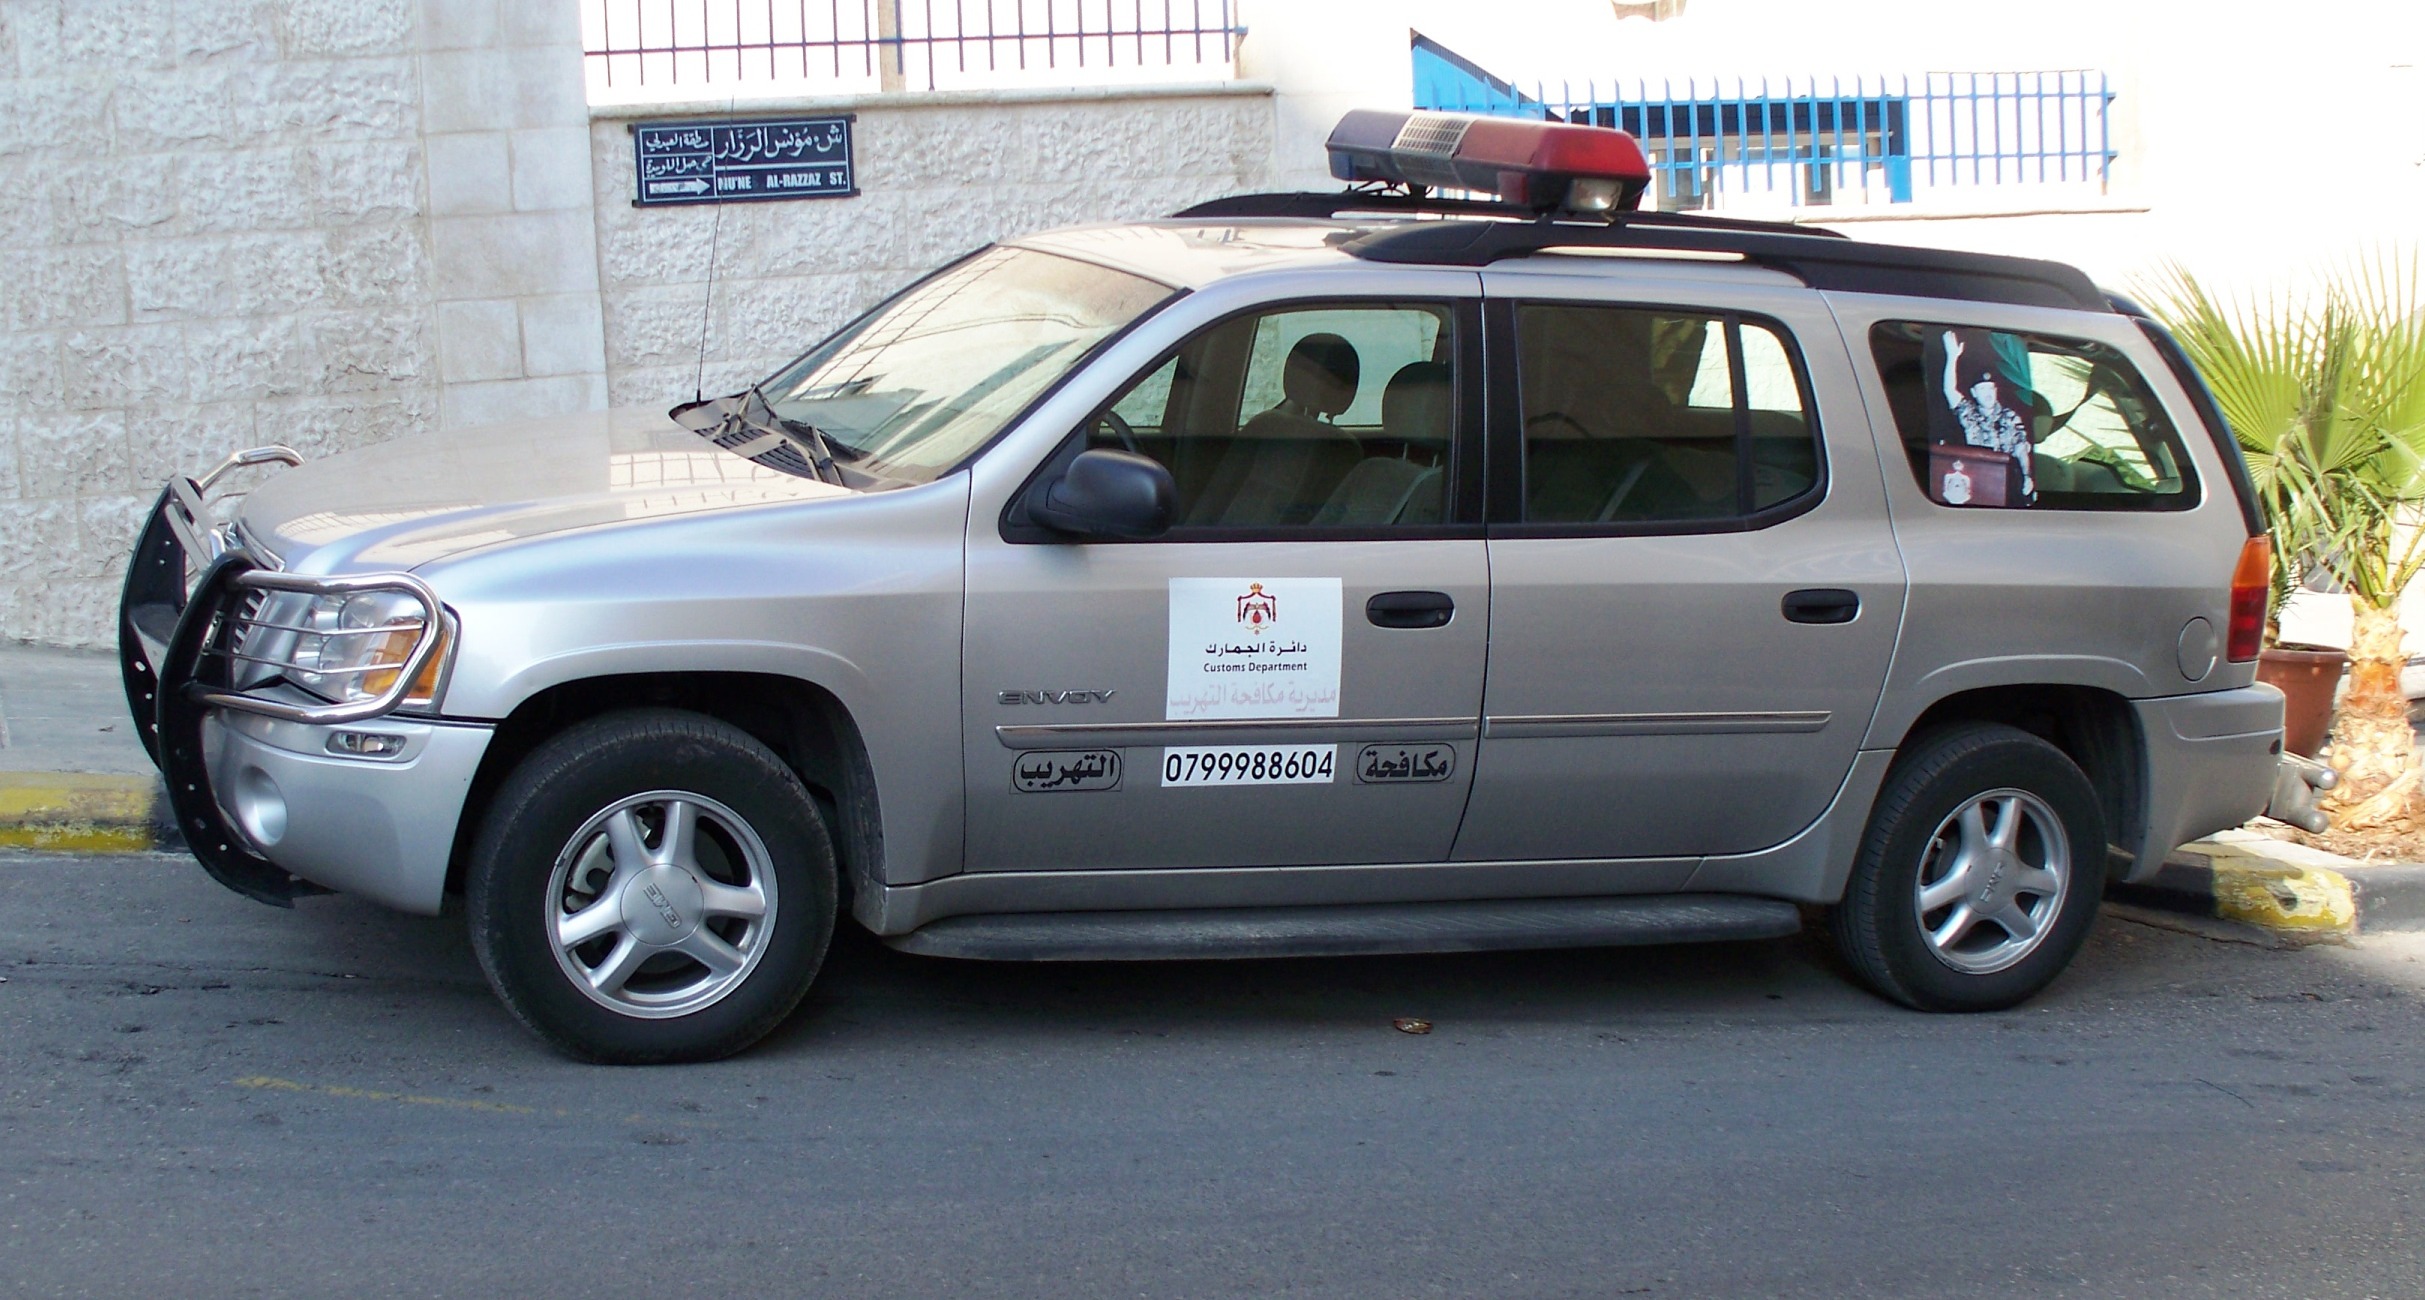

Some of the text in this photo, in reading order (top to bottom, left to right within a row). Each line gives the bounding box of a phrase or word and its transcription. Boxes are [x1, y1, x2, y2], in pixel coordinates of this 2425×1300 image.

[646, 130, 710, 152] منطقة العبدلي
[766, 172, 822, 189] AL-RAZZAZ
[829, 172, 847, 186] ST.
[1205, 640, 1307, 658] دائرة الجمارك
[1203, 661, 1308, 674] Customs Department
[998, 690, 1116, 705] ENVOY
[1169, 680, 1337, 716] مديرية مكافحة التهريب
[1020, 754, 1115, 788] التهريب
[1165, 750, 1334, 782] 0799988604
[1365, 750, 1449, 778] مكافحة
[642, 882, 683, 929] GMC
